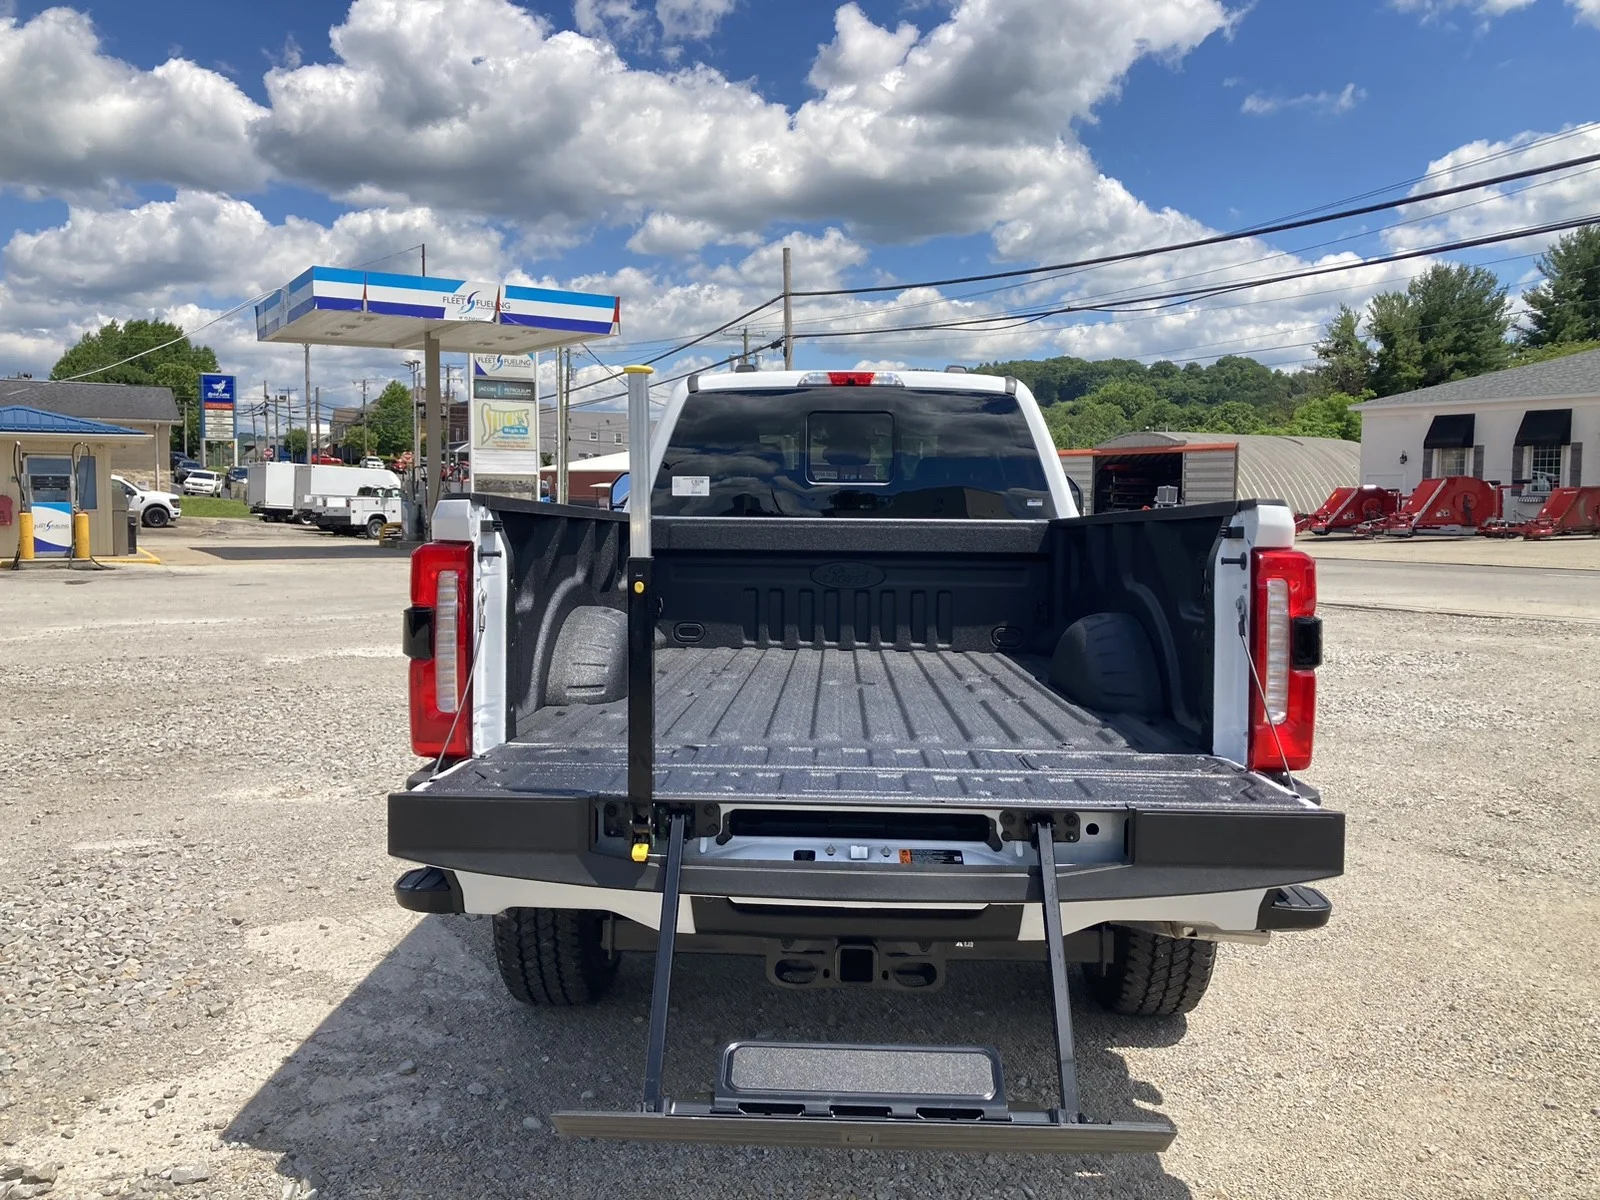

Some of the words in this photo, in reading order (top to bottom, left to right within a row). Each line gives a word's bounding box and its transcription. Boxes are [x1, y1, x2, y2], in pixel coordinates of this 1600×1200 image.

[442, 295, 466, 305] FLEET
[478, 356, 496, 364] FLEET
[504, 358, 531, 366] FUELING
